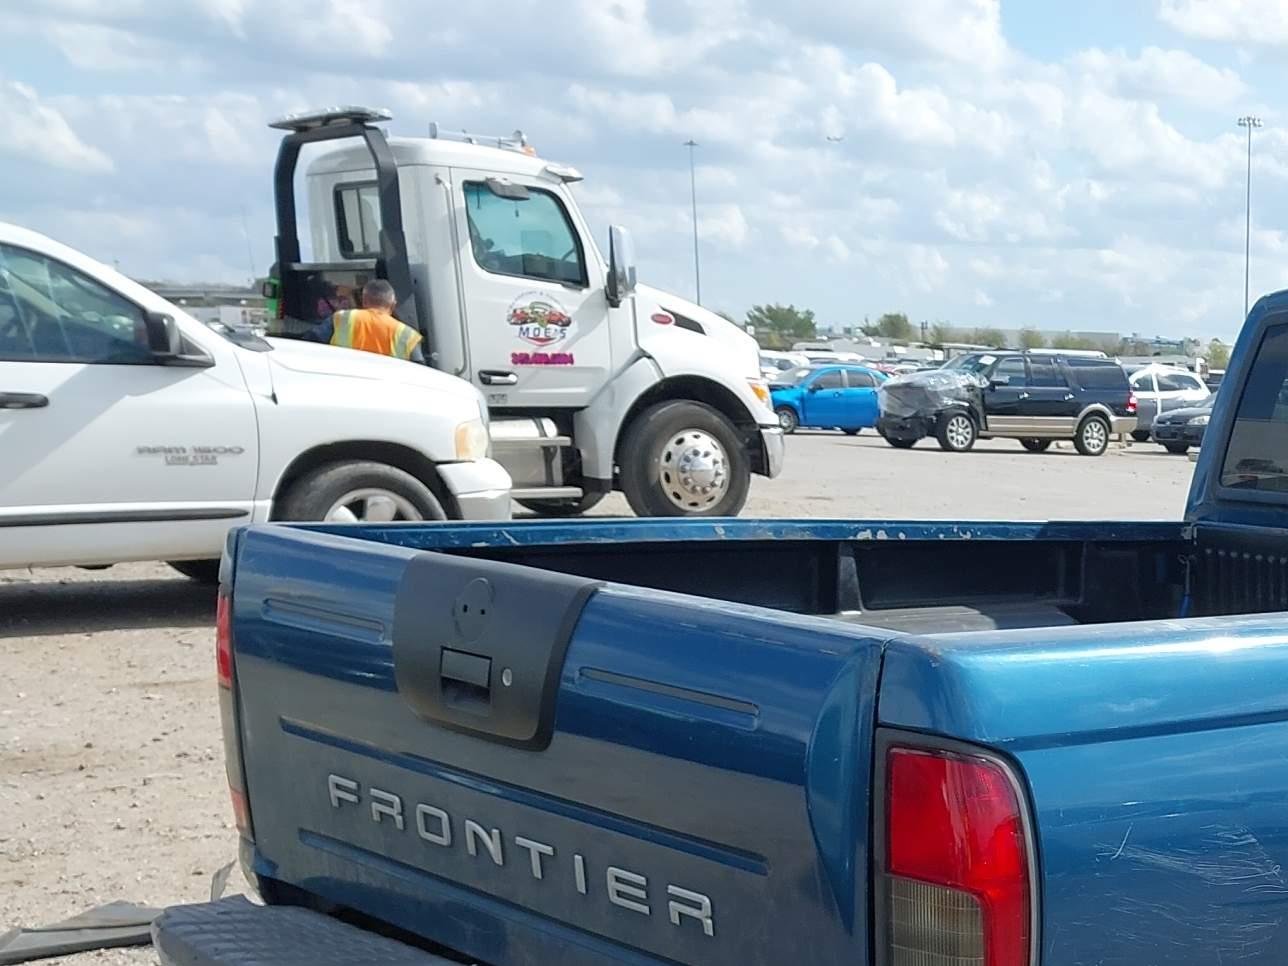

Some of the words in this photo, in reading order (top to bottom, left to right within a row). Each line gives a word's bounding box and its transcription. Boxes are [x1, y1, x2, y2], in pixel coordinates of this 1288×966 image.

[518, 326, 567, 339] MOE'S
[136, 445, 187, 455] RAM
[192, 445, 245, 455] 1500
[165, 455, 189, 464] LONE
[190, 455, 218, 465] STAR
[328, 773, 716, 937] FRONTIER
